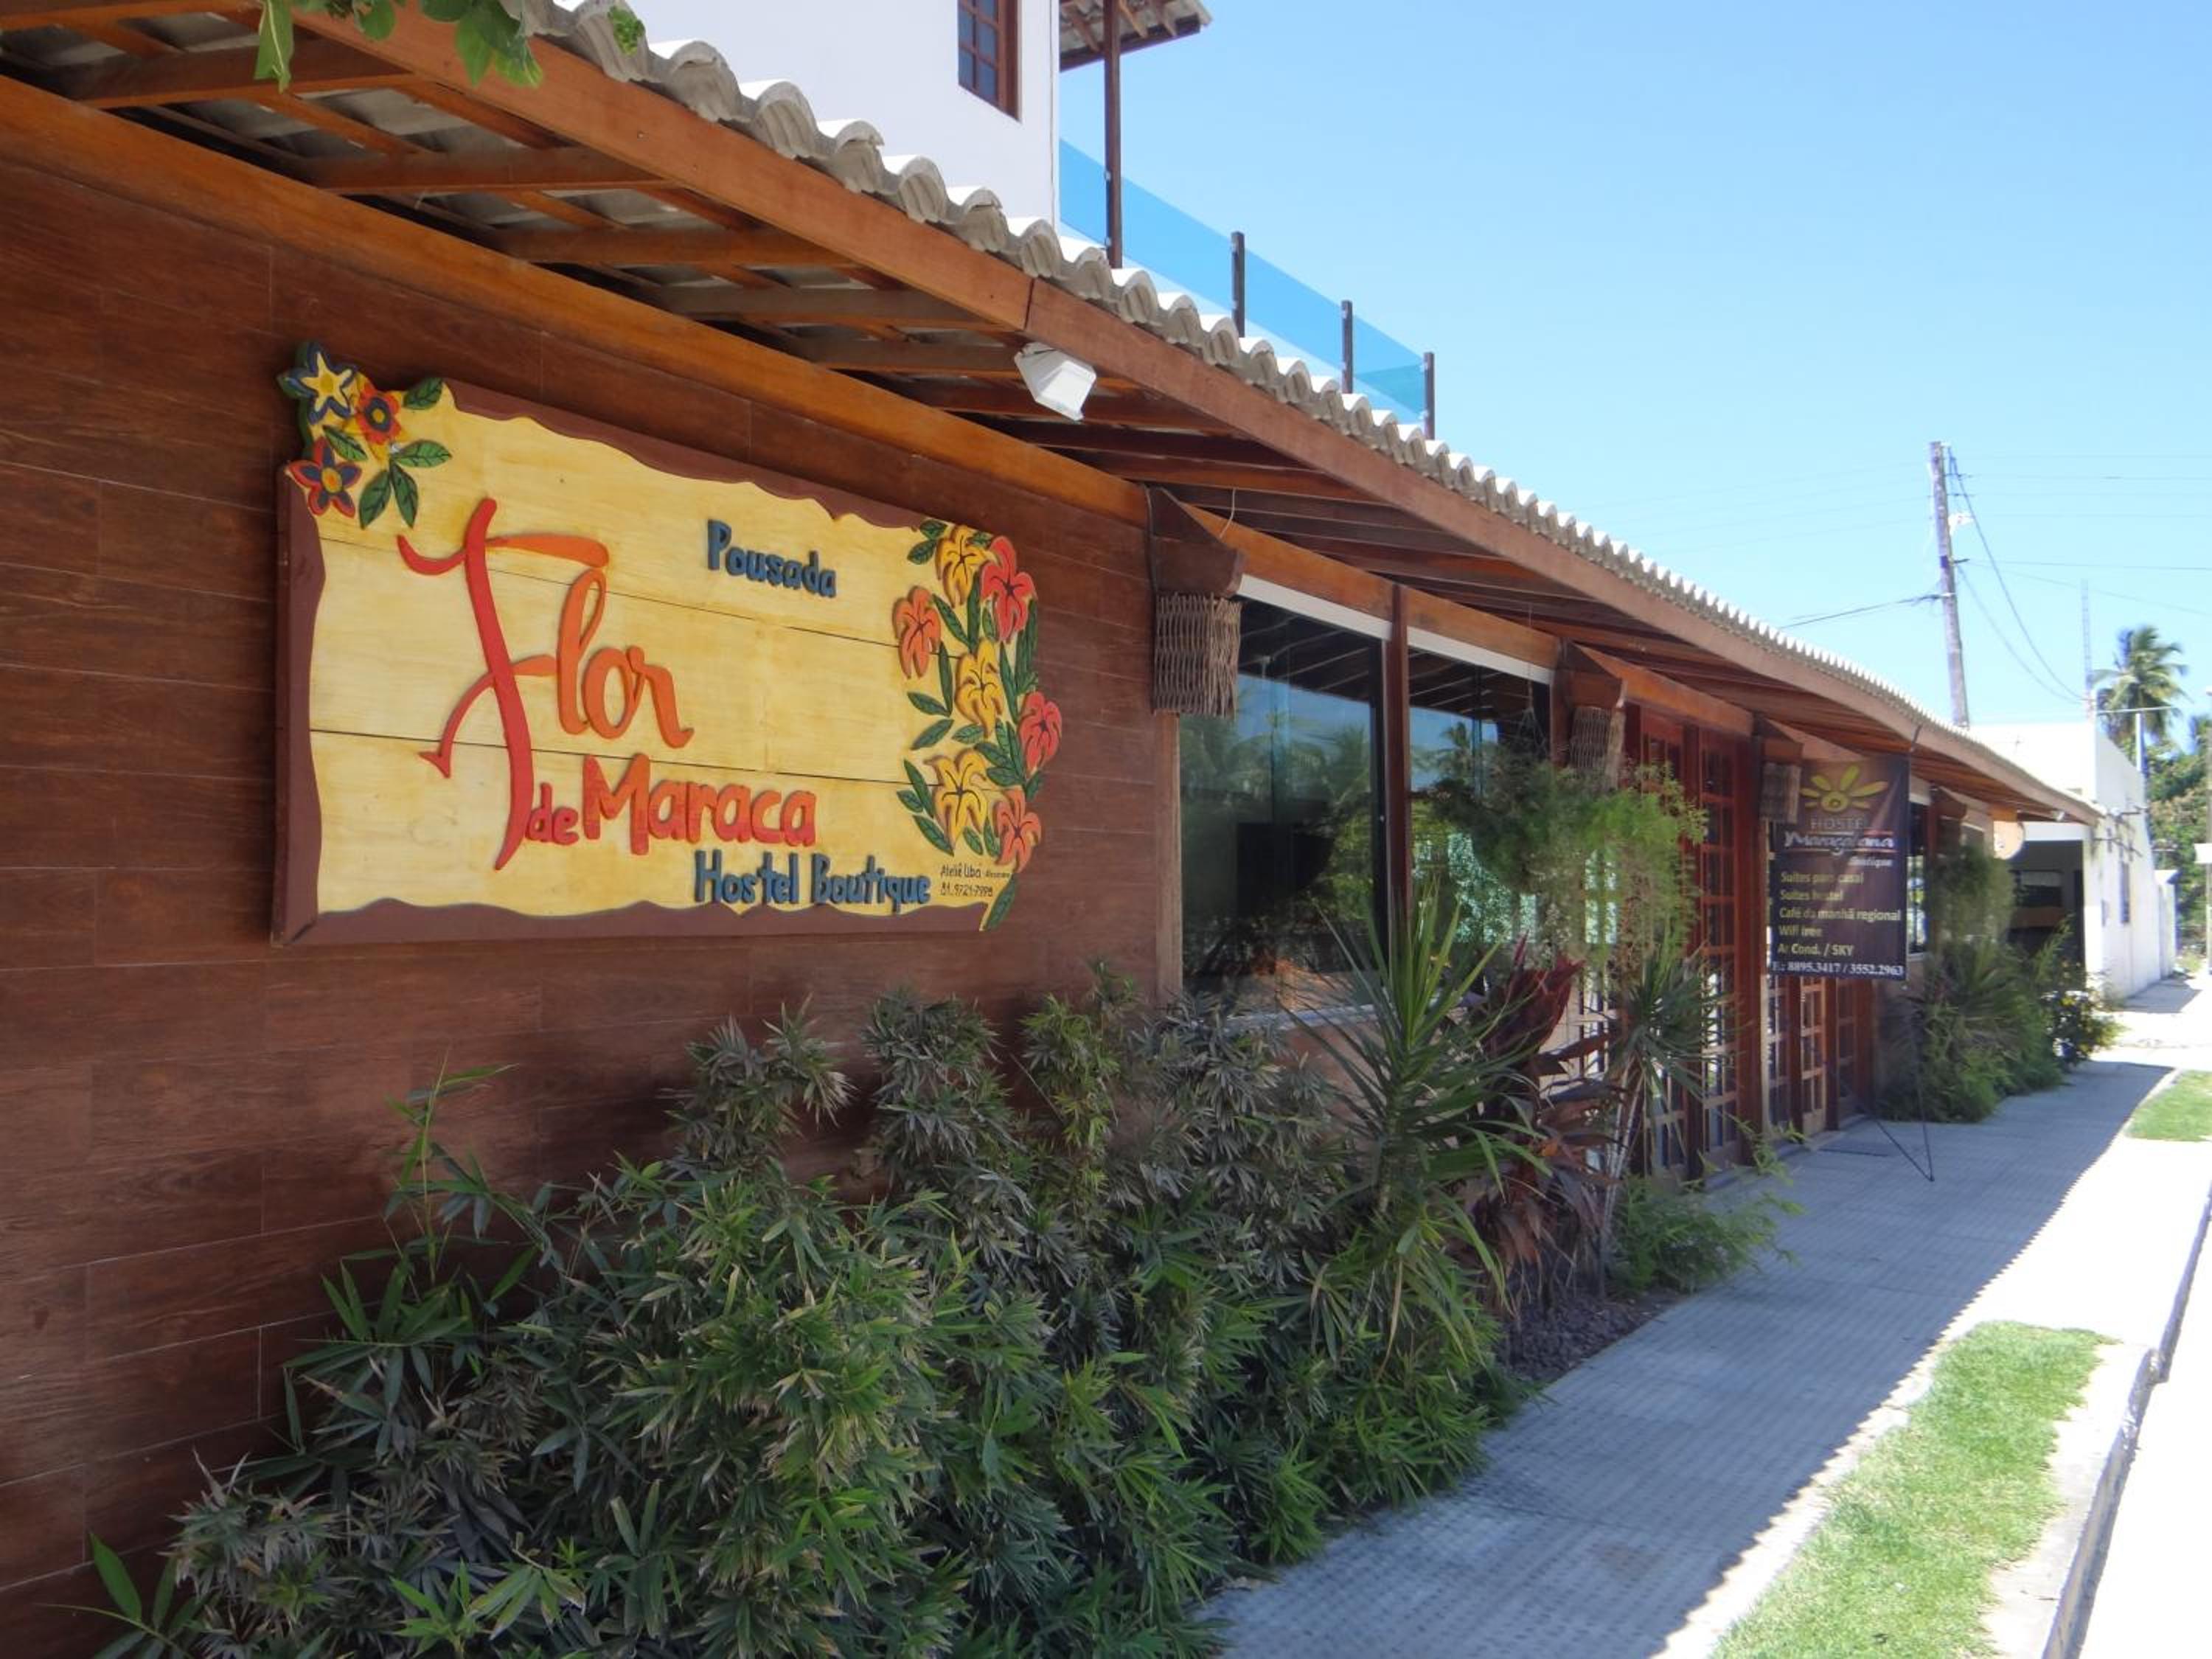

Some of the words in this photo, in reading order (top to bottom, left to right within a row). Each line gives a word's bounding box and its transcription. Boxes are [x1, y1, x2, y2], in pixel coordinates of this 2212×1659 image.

[708, 519, 836, 598] Pousada
[397, 498, 695, 870] Flor
[524, 782, 580, 846] de
[582, 753, 816, 855] Maraca
[695, 849, 799, 905] Hostel
[811, 853, 931, 914] Boutique
[1857, 908, 1902, 923] regional
[1832, 944, 1854, 956] SKY
